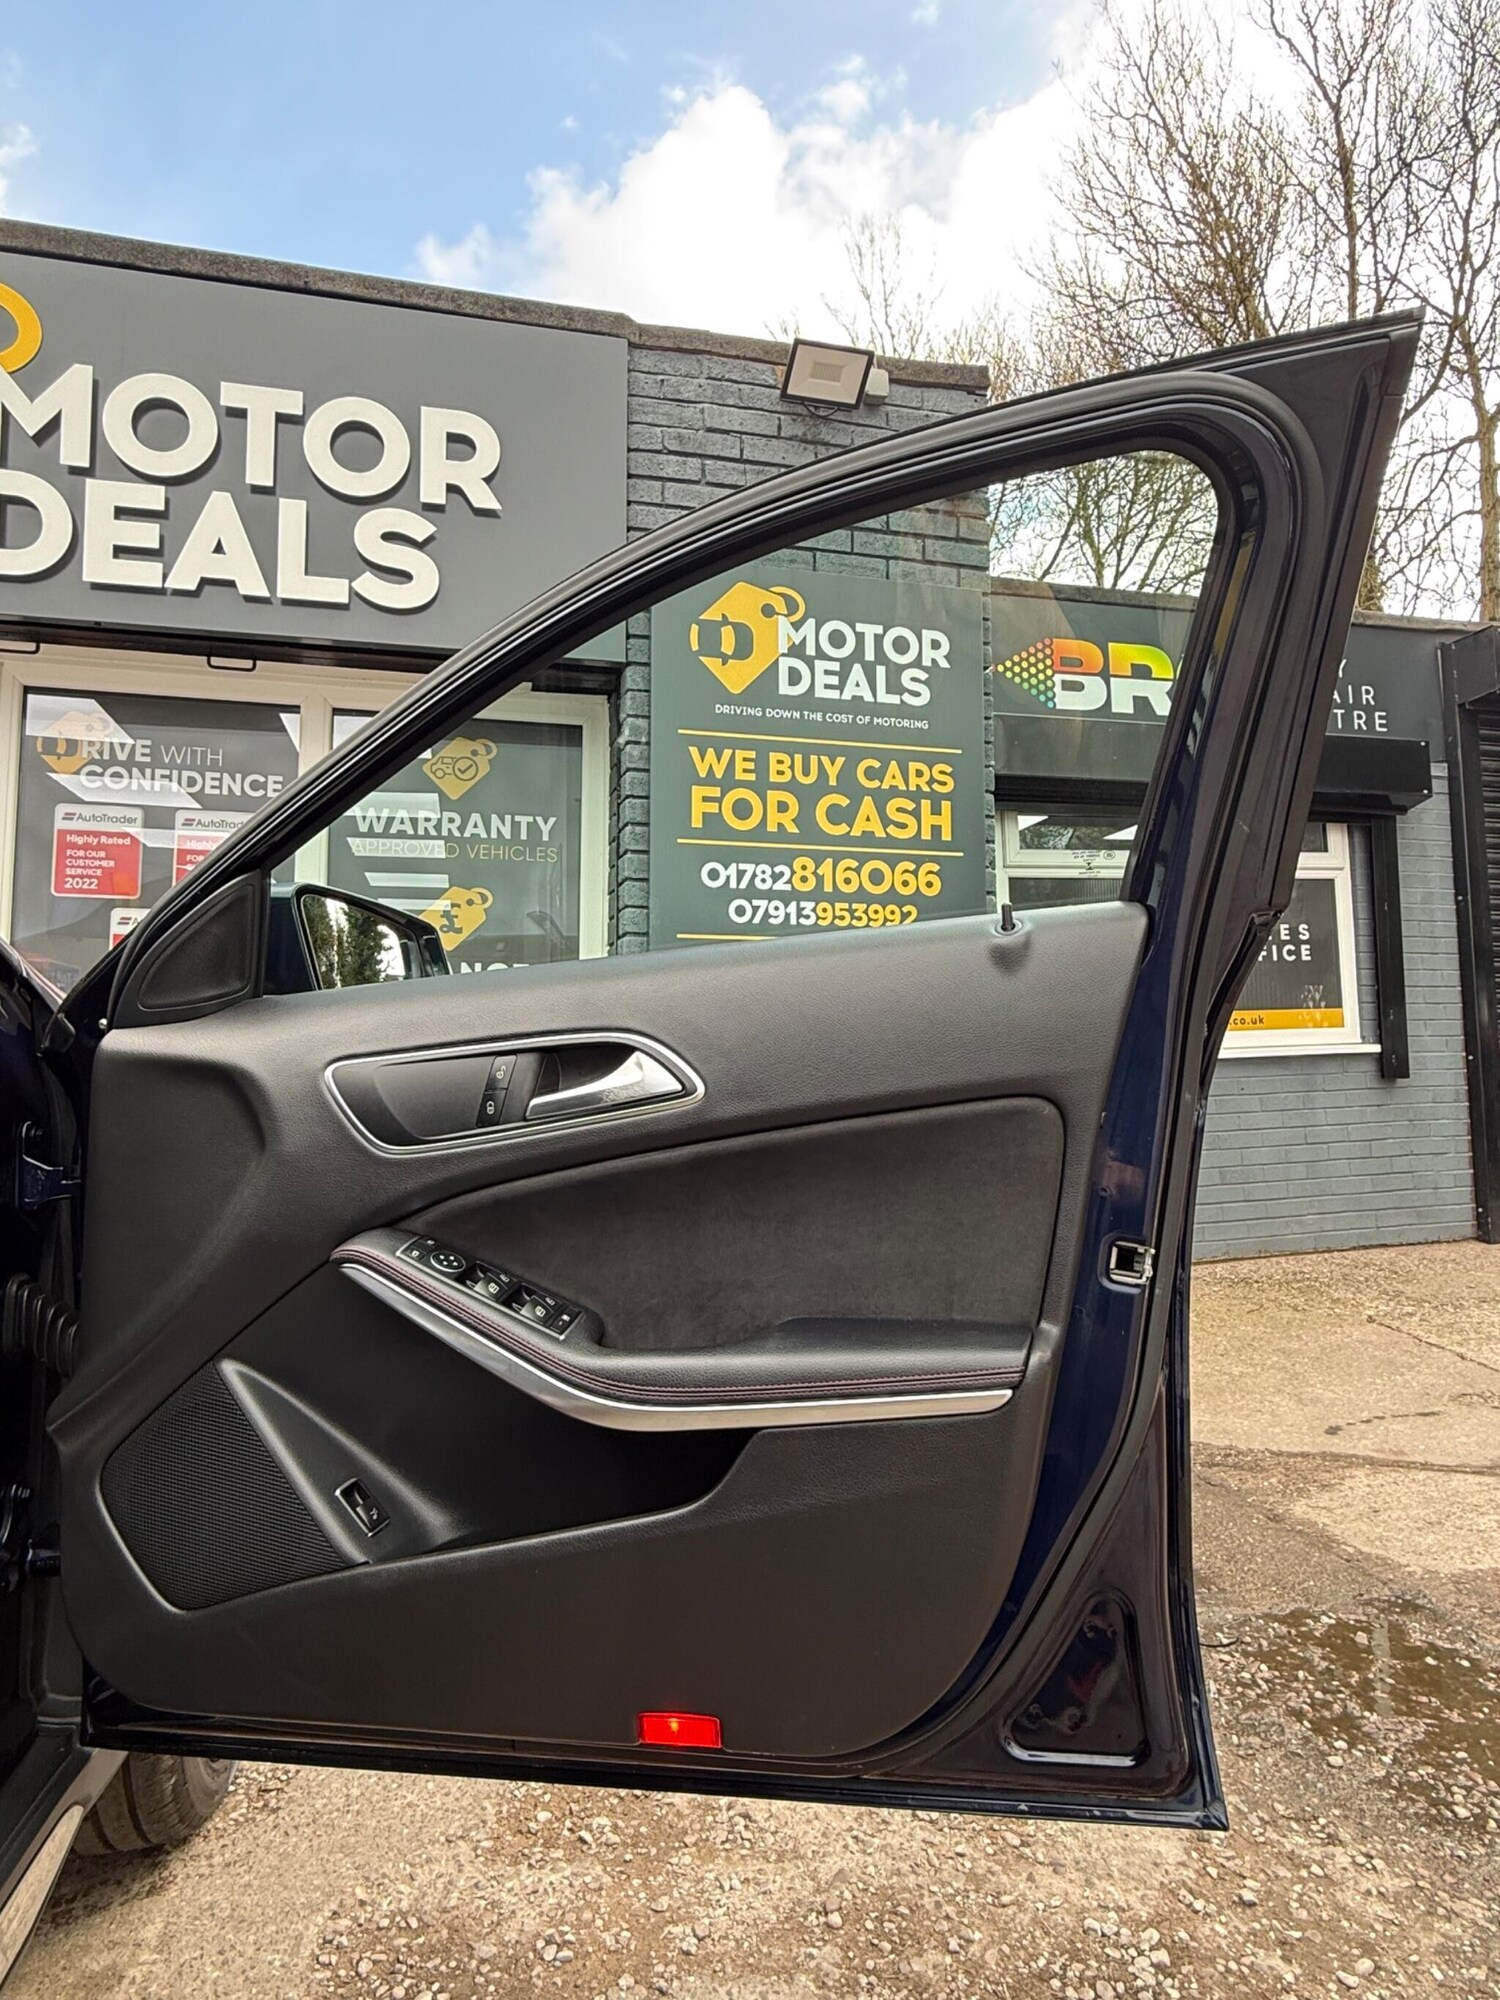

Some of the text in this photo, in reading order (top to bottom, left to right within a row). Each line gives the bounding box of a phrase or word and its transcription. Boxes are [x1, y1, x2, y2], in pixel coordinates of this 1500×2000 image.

[0, 362, 502, 511] MOTOR
[0, 468, 440, 610] DEALS
[778, 615, 951, 669] MOTOR
[778, 656, 931, 707] DEALS
[1051, 637, 1183, 716] BR
[715, 704, 929, 729] DRIVING DOWN THE COST OF MOTORING
[161, 744, 223, 768] WITH
[688, 746, 955, 793] WE BUY CARS
[79, 765, 284, 798] CONFIDENCE
[76, 813, 138, 825] AutoTrader
[355, 806, 558, 842] WARRANTY
[690, 784, 953, 842] FOR CASH
[66, 834, 131, 845] Highly Rated
[66, 849, 106, 858] FOR OUR
[352, 839, 558, 863] APPROVED VEHICLES
[65, 858, 115, 868] CUSTOMER
[65, 867, 103, 876] SERVICE
[701, 856, 942, 897] 01782816066
[64, 877, 99, 889] 2022
